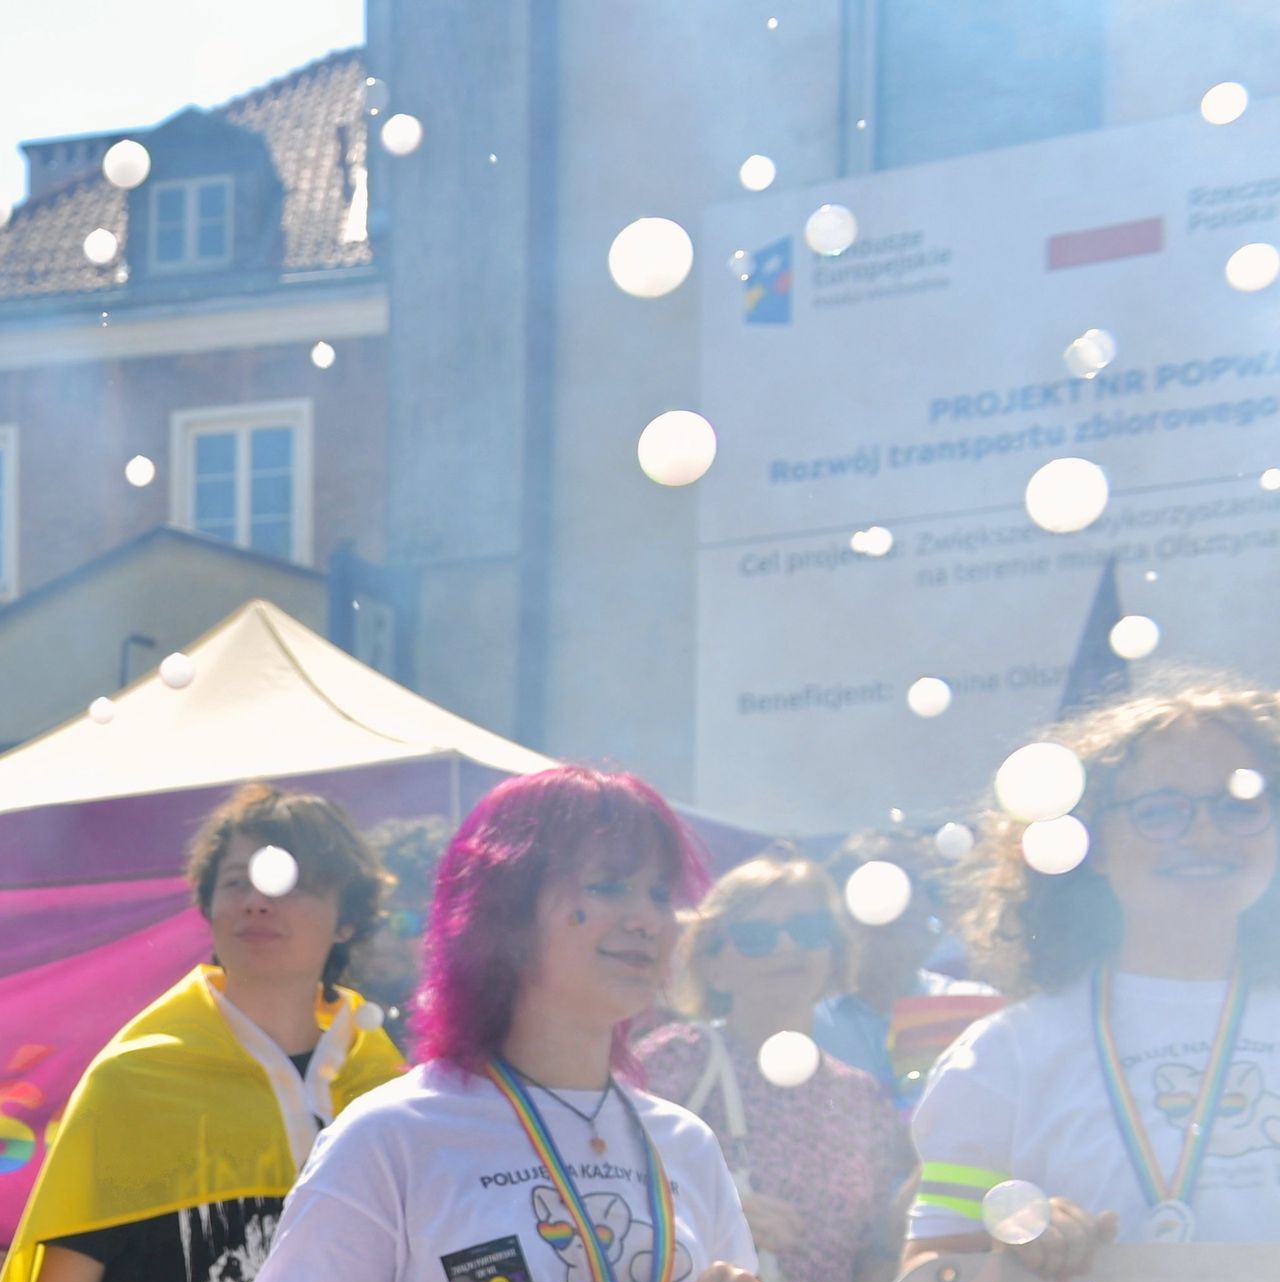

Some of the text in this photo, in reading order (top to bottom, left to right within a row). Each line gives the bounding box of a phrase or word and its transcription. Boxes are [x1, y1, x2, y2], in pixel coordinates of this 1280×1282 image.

[930, 377, 1083, 423] PROJEKT
[1095, 366, 1145, 399] NR
[768, 394, 1278, 485] Rozwój transportu zbiorowego
[480, 1164, 550, 1189] POLUJĘ
[581, 1160, 633, 1180] KAŻDY
